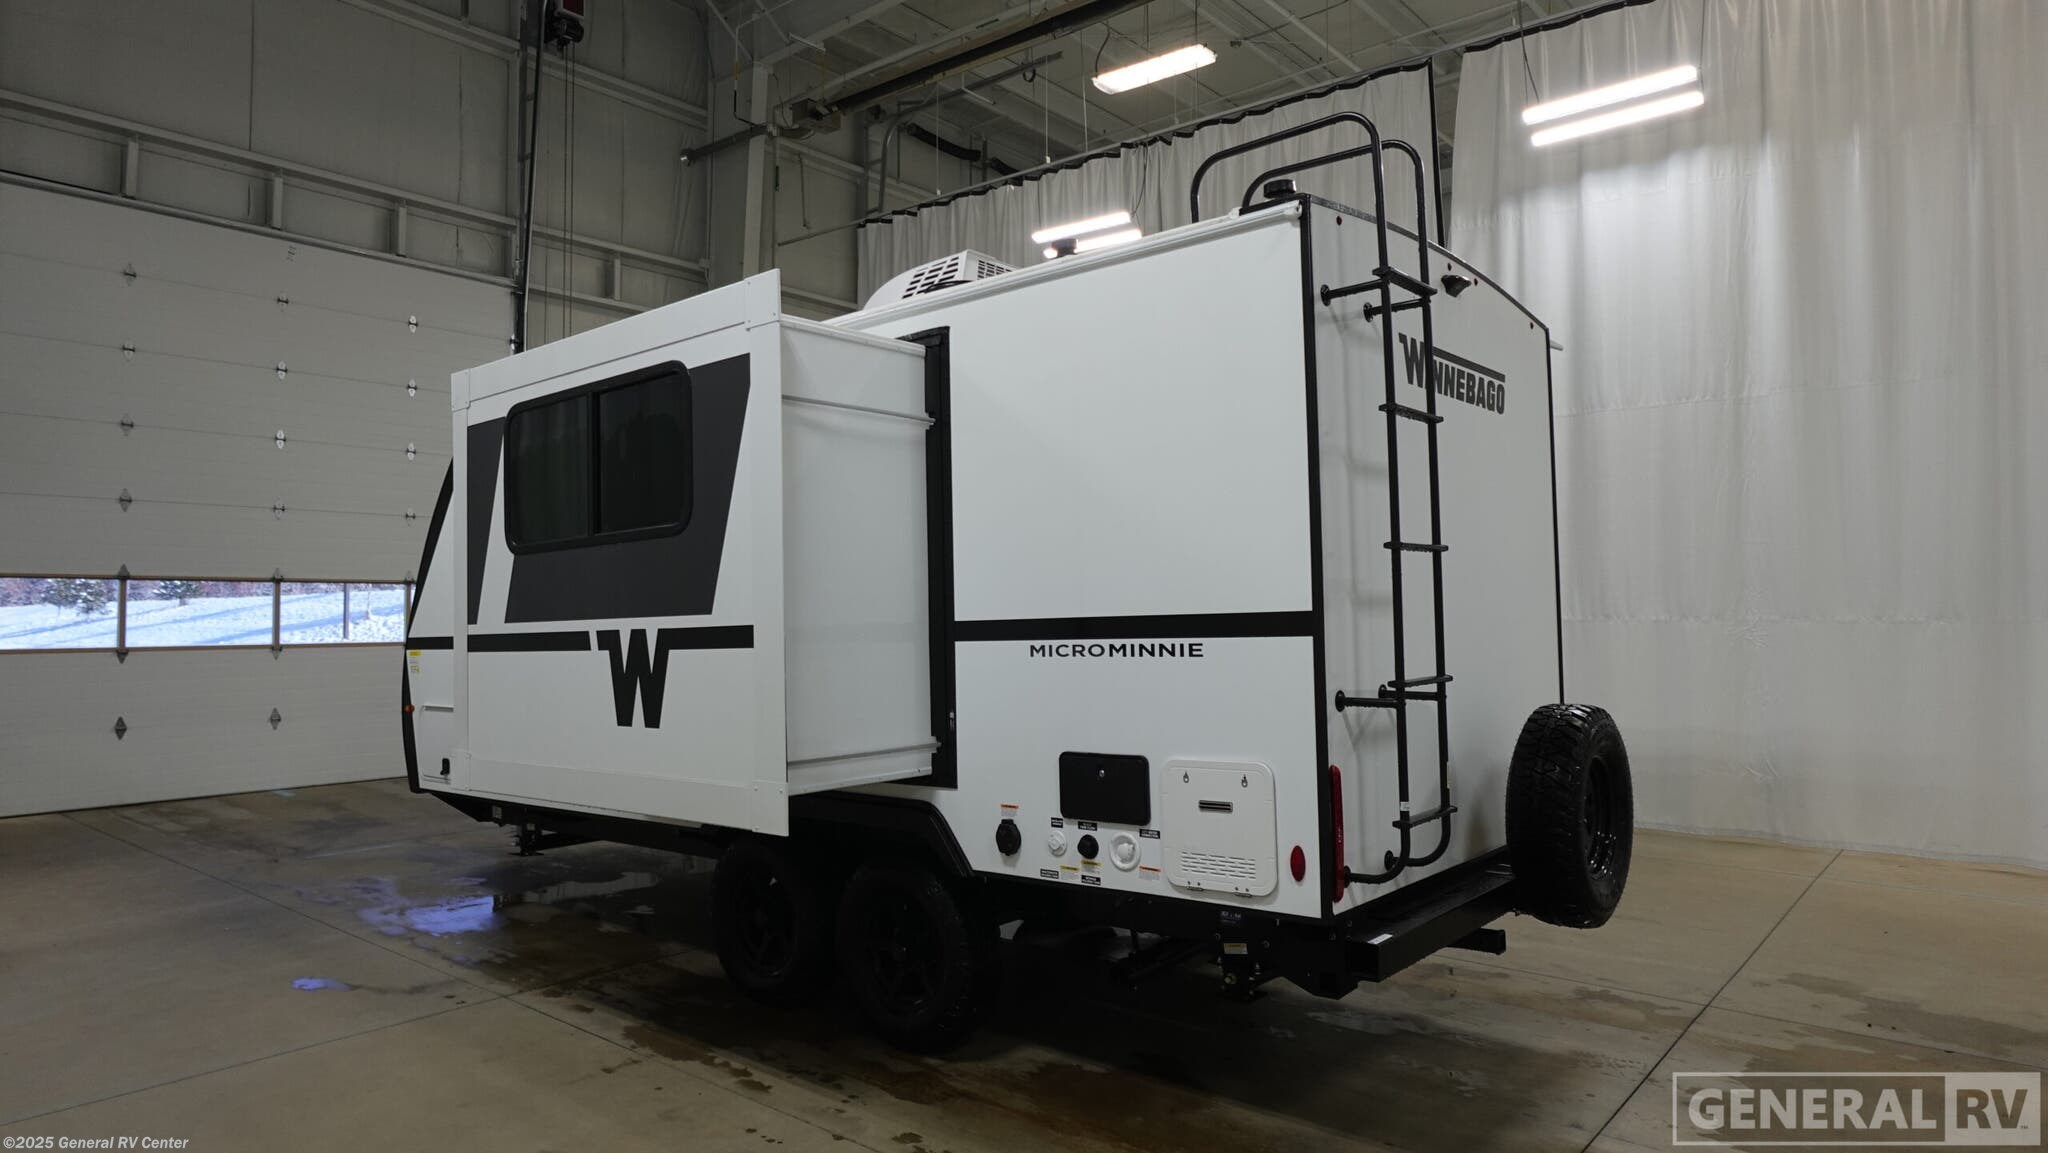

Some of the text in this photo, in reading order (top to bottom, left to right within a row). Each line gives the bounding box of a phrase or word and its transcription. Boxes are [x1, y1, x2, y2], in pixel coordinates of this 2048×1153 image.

[1398, 332, 1506, 415] WNNEBAGO
[596, 628, 671, 729] W
[1029, 642, 1204, 658] MICROMINNIE
